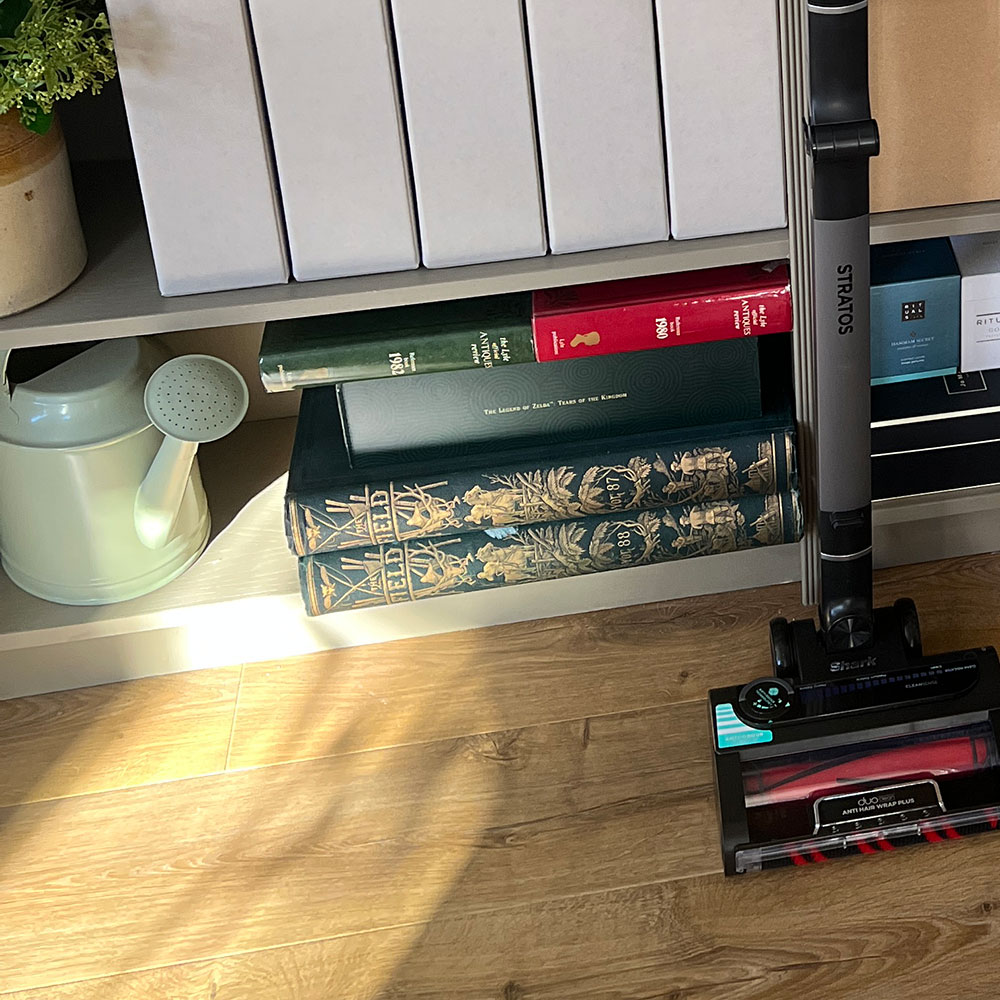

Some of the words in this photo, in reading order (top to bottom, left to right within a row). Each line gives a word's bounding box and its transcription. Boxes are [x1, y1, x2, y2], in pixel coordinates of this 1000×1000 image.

[836, 264, 854, 336] STRATOS
[741, 299, 752, 336] ANTIQUES
[758, 304, 767, 315] the
[733, 310, 741, 330] review
[759, 315, 768, 328] Lyle
[655, 317, 669, 340] 1980
[499, 337, 509, 348] the
[470, 343, 481, 365] review
[500, 348, 511, 362] Lyle
[388, 352, 405, 376] 1982
[606, 477, 620, 491] 87
[617, 531, 631, 547] 88
[829, 656, 877, 672] Shark
[842, 807, 858, 816] ANTI
[859, 804, 876, 813] HAIR
[876, 801, 897, 809] WRAP
[897, 798, 915, 806] PLUS
[857, 796, 879, 806] duo
